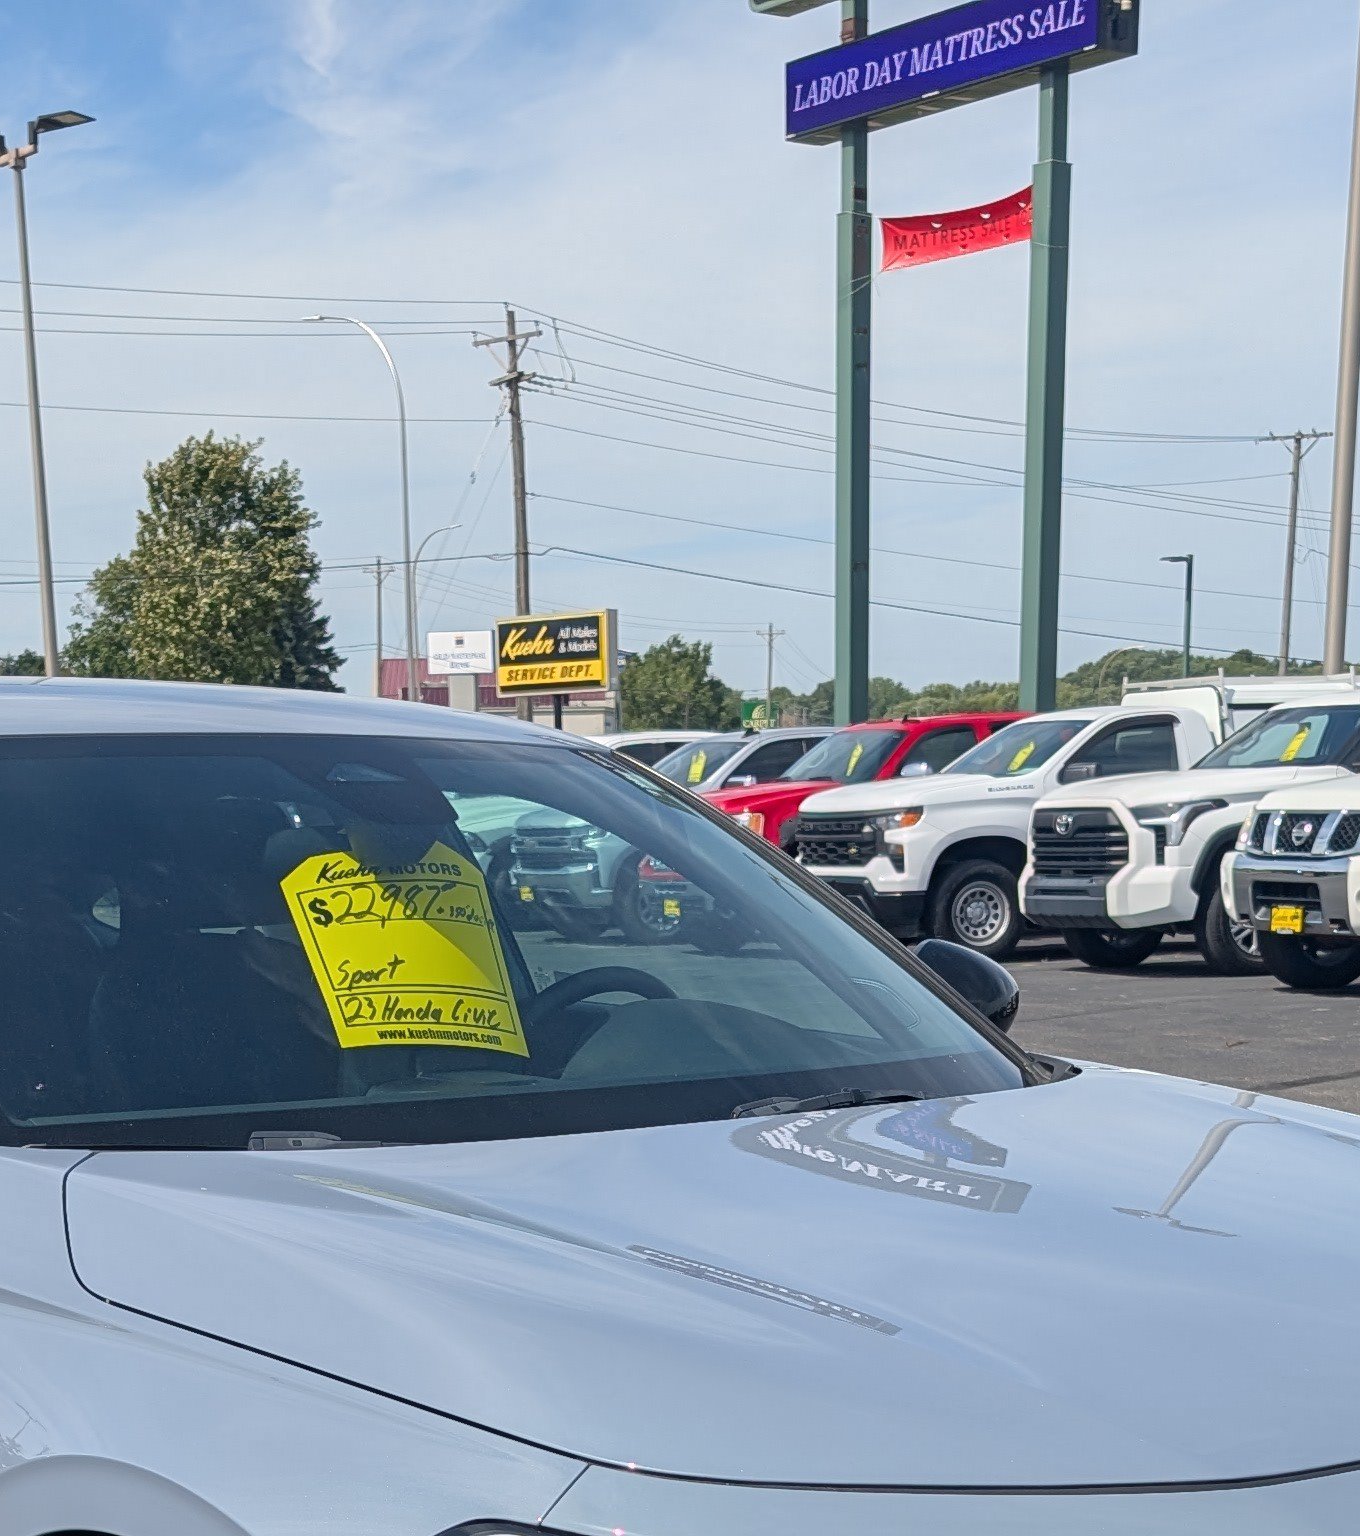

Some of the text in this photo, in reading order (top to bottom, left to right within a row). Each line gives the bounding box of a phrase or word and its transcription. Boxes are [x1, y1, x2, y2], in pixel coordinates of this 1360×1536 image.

[793, 0, 1087, 112] LABOR DAY MATTRESS SALE
[893, 218, 1011, 251] MATTRESS SALE
[501, 624, 555, 660] Kuehn
[507, 664, 594, 682] SERVICE DEPT.
[316, 860, 462, 884] Kuehn MOTORS
[337, 953, 406, 991] Sport
[344, 994, 501, 1030] 23 Honda Civic
[376, 1028, 503, 1047] www.kuehnmotors.com
